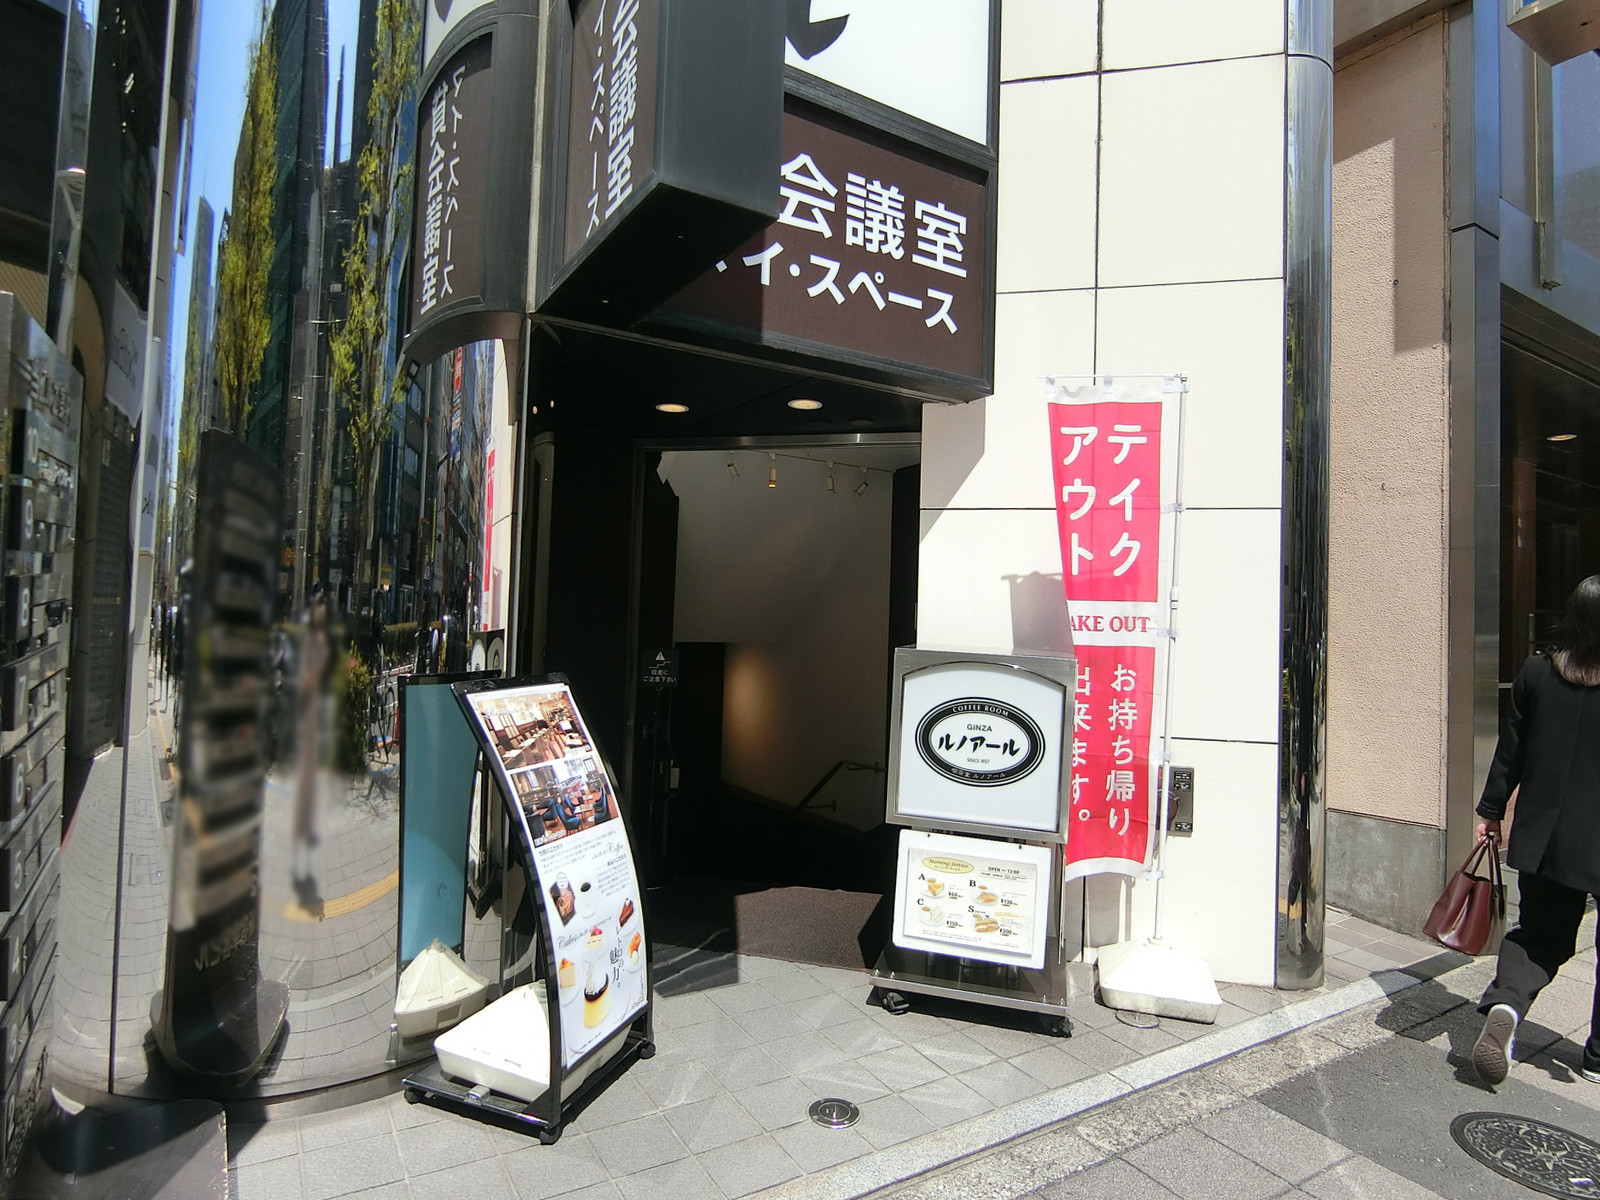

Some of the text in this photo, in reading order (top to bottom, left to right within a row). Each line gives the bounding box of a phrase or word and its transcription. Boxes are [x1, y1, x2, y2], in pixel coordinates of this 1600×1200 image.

[777, 152, 968, 278] 会議室
[715, 241, 958, 335] イ・スペース
[1060, 426, 1098, 576] アウト
[1107, 424, 1147, 577] テイク
[20, 588, 30, 628] 8
[1109, 616, 1151, 633] OUT
[18, 676, 27, 716] 7
[952, 704, 1009, 717] COFFEE ROOM
[937, 733, 1020, 757] ルノアール
[966, 723, 993, 732] GINZA
[1105, 664, 1138, 837] お持ち帰り
[15, 761, 25, 804] 6
[13, 855, 23, 891] 5
[918, 873, 926, 881] A
[967, 905, 975, 913] S
[11, 935, 21, 975] 4
